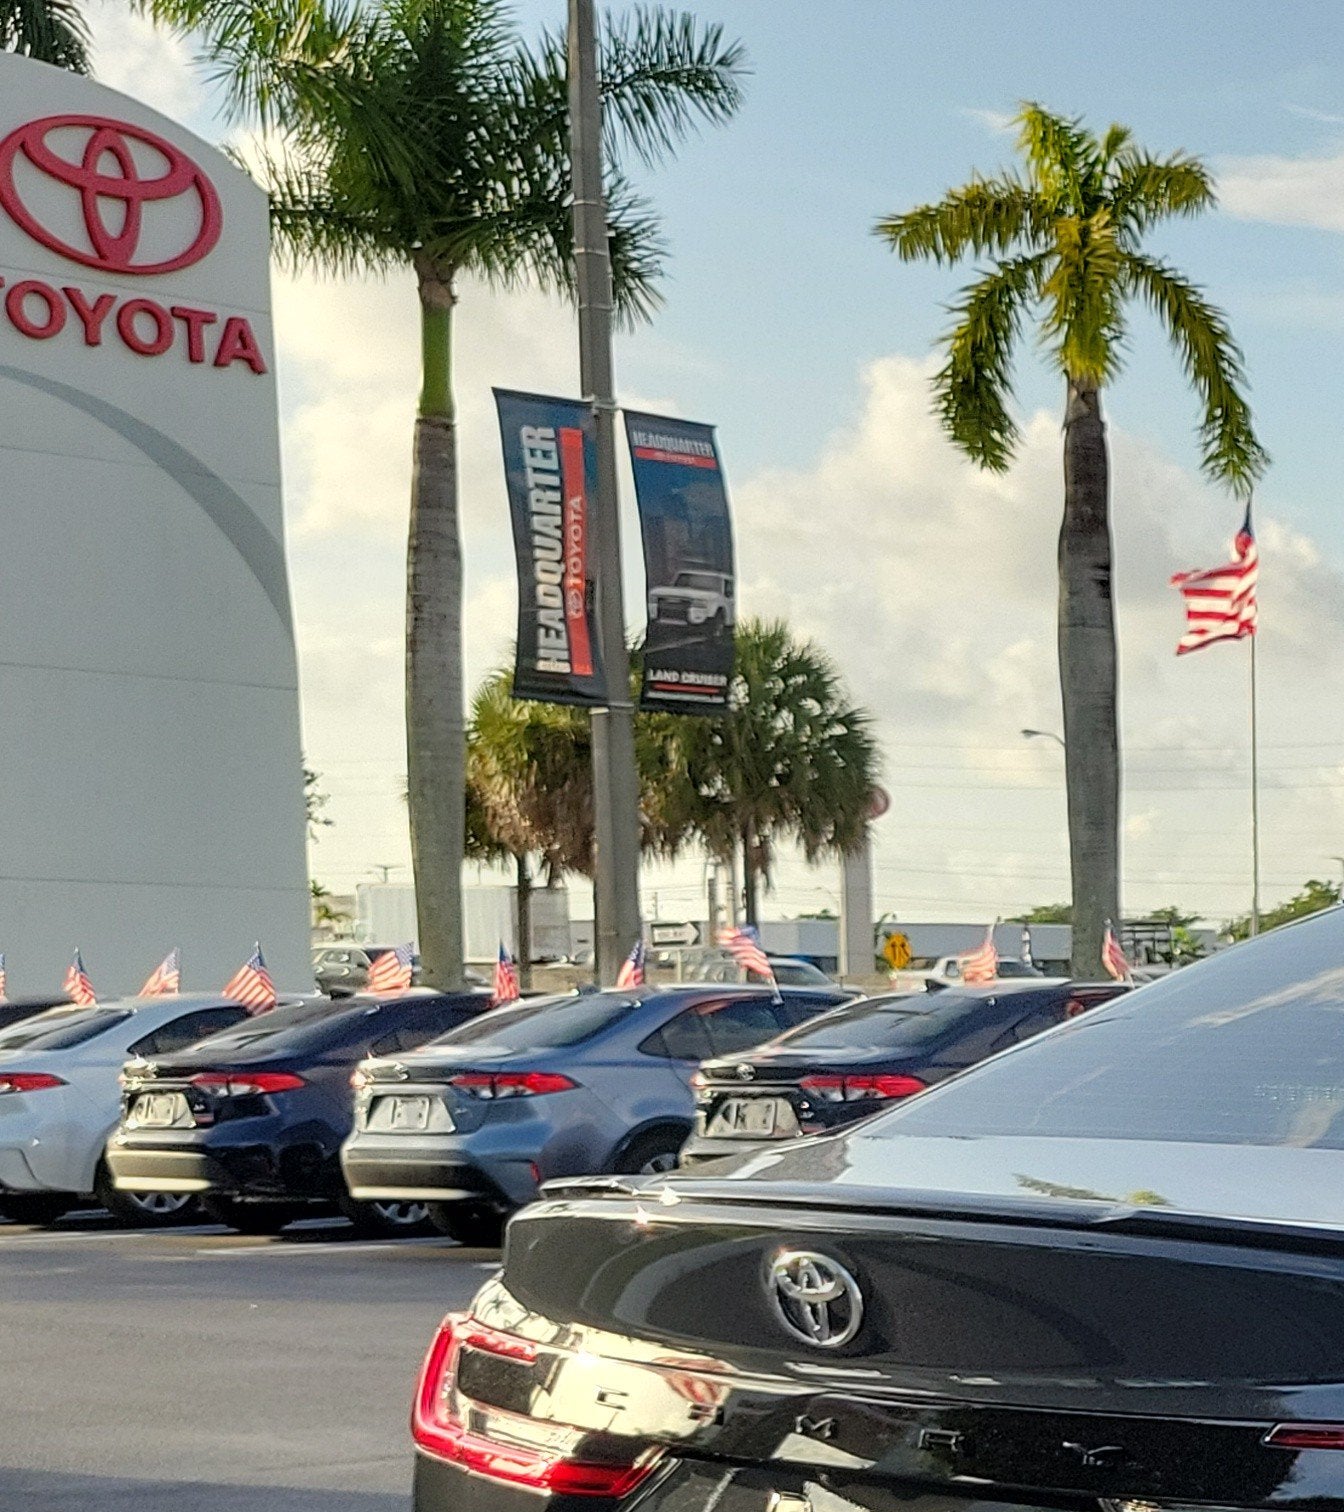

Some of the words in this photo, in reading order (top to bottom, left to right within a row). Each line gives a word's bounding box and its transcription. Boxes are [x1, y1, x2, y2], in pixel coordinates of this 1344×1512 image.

[0, 276, 268, 375] OYOTA
[520, 425, 572, 674] HEADQUARTER
[570, 496, 583, 585] TOYOTA
